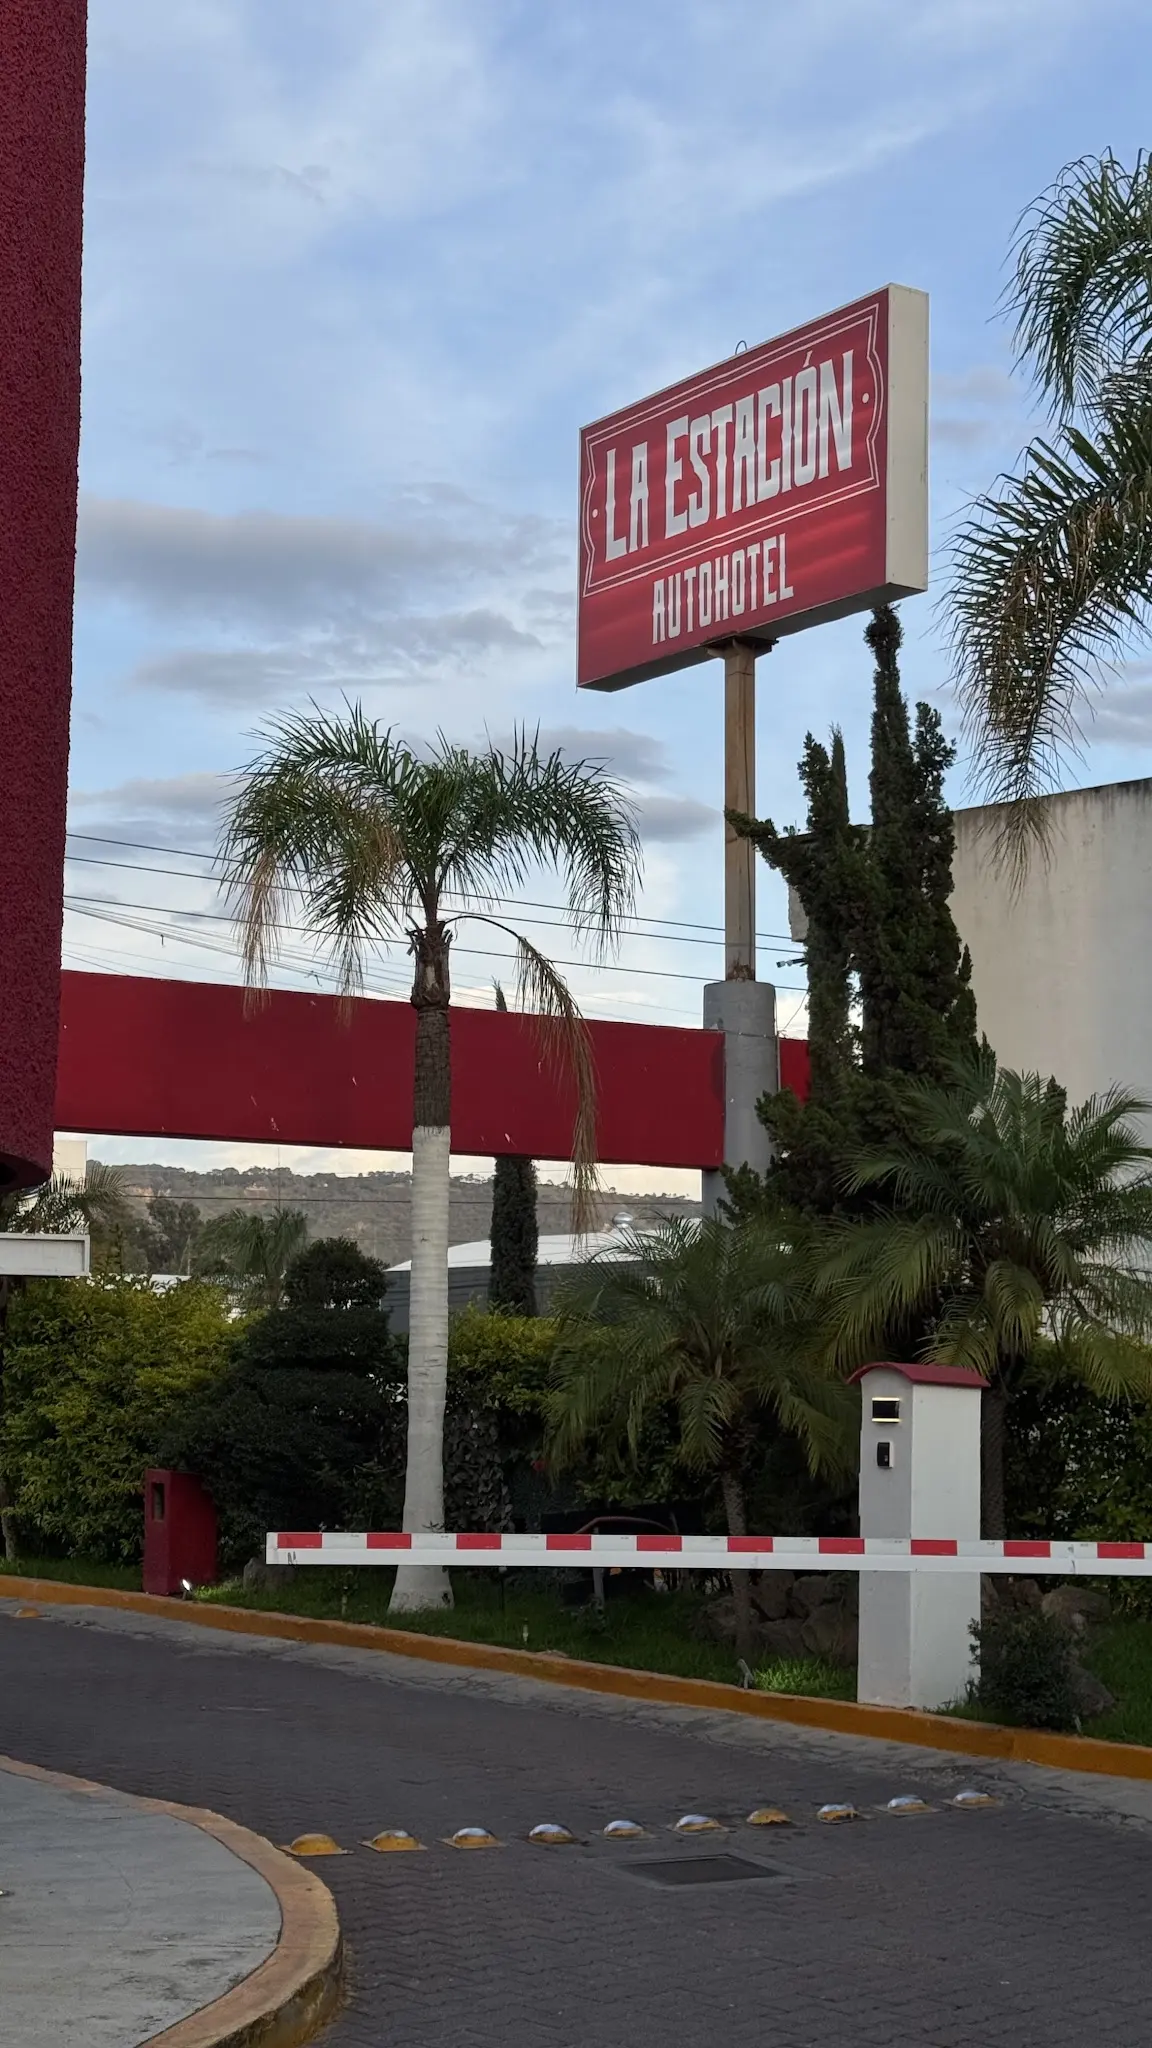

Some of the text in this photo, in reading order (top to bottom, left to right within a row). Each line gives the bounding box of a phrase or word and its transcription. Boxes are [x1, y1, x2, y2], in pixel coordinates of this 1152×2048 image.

[604, 349, 855, 562] LA ESTACIÓN
[651, 533, 794, 645] AUTOHOTEL
